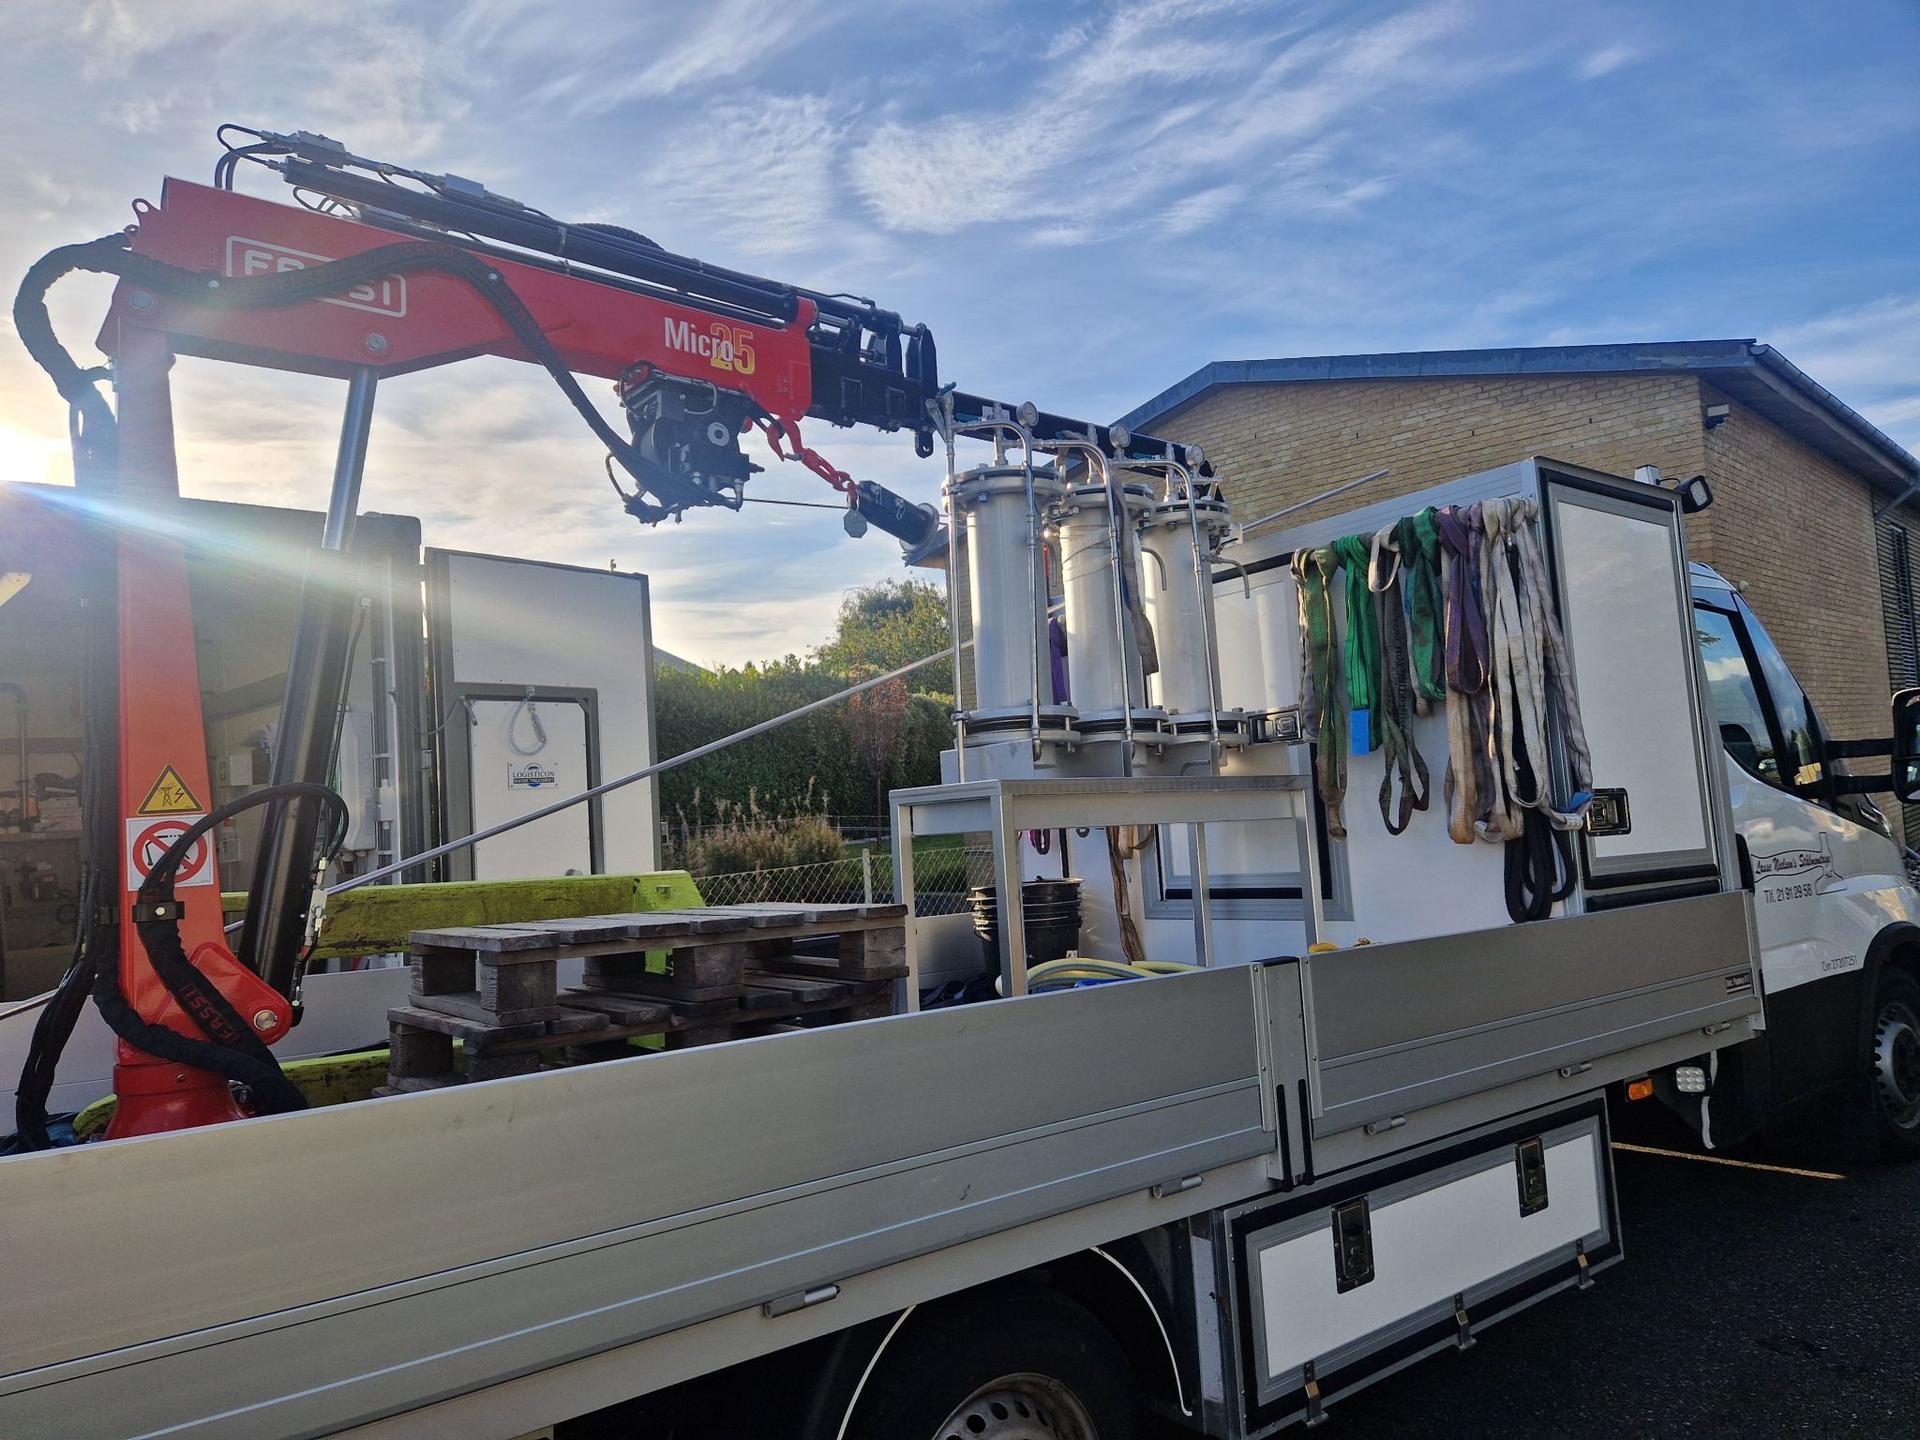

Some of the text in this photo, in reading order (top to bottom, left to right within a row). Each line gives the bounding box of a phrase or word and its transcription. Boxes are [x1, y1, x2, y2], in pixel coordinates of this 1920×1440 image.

[664, 316, 756, 375] Micro 25
[1756, 861, 1772, 875] Lasse
[1777, 888, 1785, 902] 21
[1785, 887, 1793, 901] 91
[1794, 885, 1803, 899] 29
